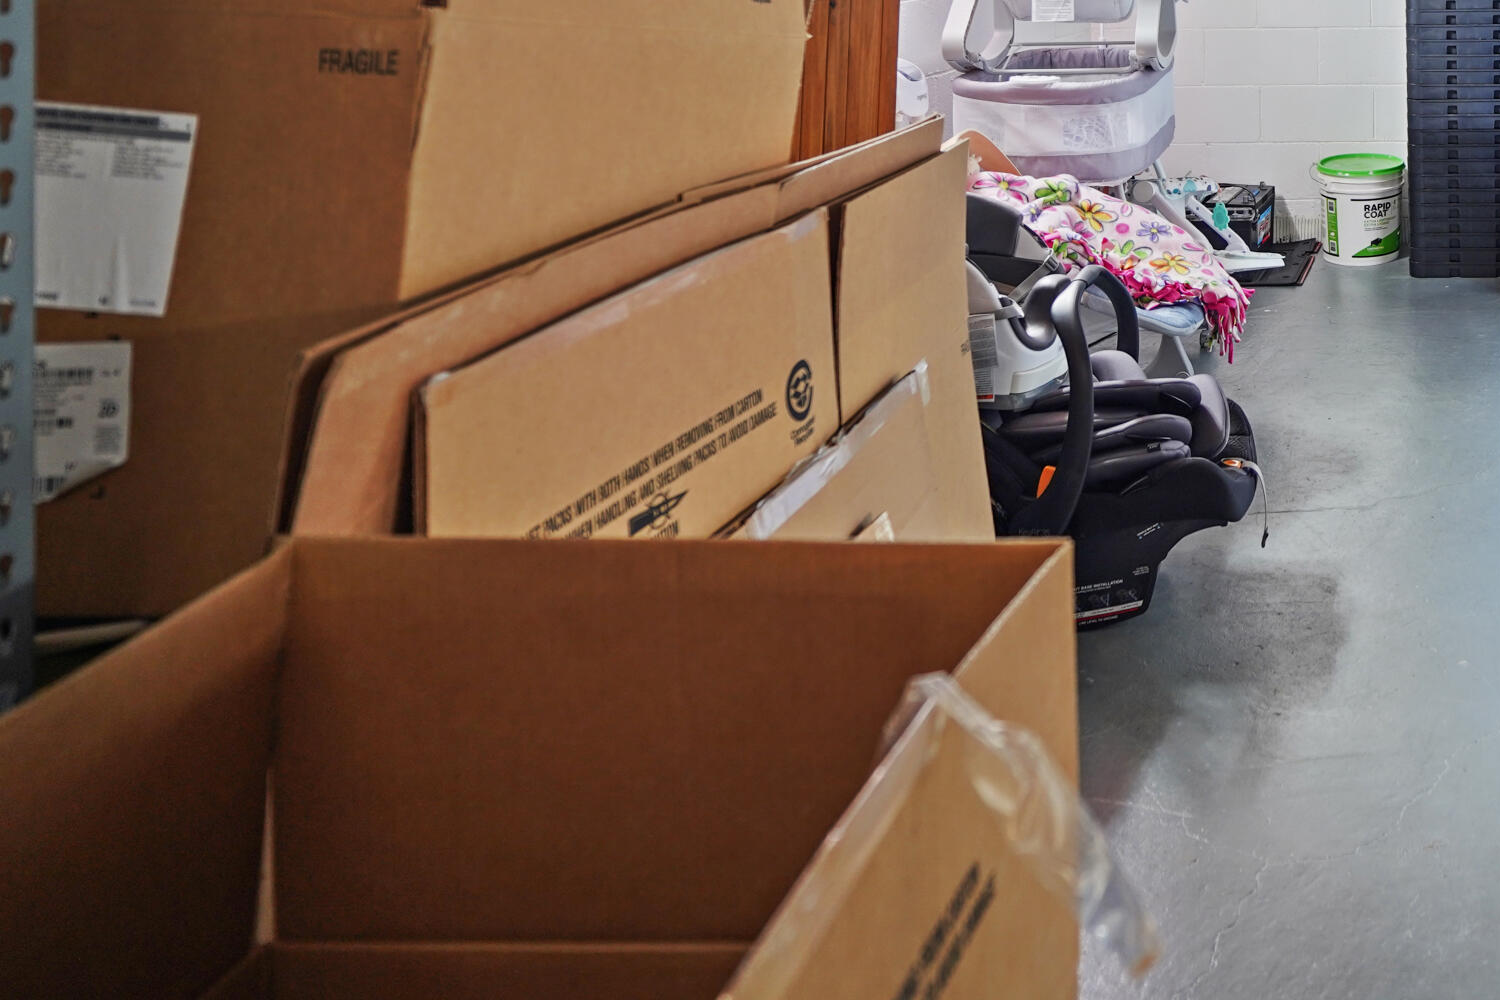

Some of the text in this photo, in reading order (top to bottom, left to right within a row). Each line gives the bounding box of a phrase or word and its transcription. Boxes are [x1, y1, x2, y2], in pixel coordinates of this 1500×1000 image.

[318, 48, 400, 76] FRAGILE
[1364, 202, 1391, 211] RAPID
[1364, 209, 1388, 218] COAT
[574, 488, 597, 515] WITH
[598, 475, 621, 499] BOTH
[621, 457, 650, 486] HANDS
[653, 441, 674, 467] WHEN
[675, 419, 714, 453] REMOVING
[714, 405, 736, 430] FROM
[735, 388, 763, 416] CARTON
[656, 455, 692, 489] SHELVING
[693, 440, 718, 465] PACKS
[717, 433, 727, 451] TO
[728, 420, 749, 445] AVOID
[749, 401, 778, 431] DAMAGE
